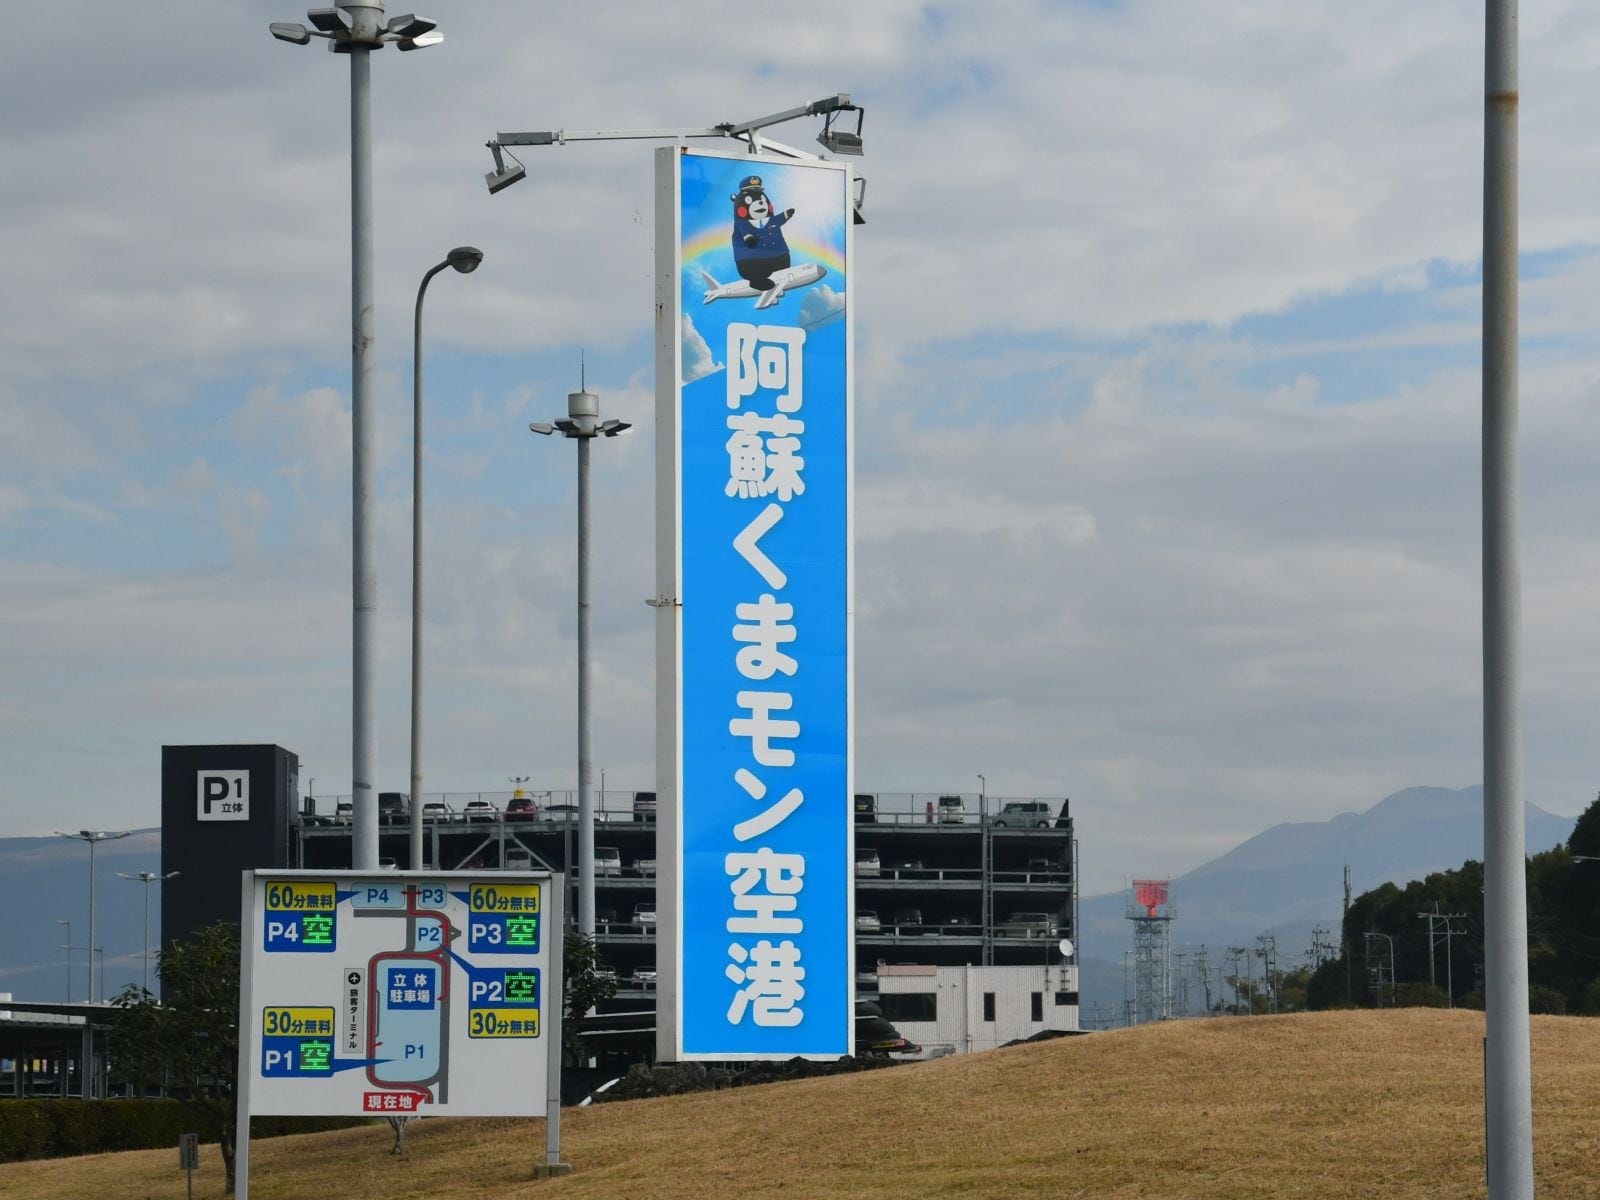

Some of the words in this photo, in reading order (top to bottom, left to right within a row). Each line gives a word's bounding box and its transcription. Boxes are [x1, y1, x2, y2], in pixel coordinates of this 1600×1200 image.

[725, 322, 806, 1027] 阿蘇くまモン空港
[204, 776, 242, 814] P1
[221, 802, 243, 813] 立体
[269, 886, 332, 908] 60分無料
[367, 889, 389, 903] P4
[422, 889, 443, 903] P3
[473, 888, 536, 910] 60分無料
[269, 922, 298, 942] P4
[303, 914, 333, 943] 空
[418, 927, 439, 941] P2
[472, 924, 501, 944] P3
[506, 916, 536, 945] 空
[394, 973, 427, 987] 立体
[472, 981, 502, 1001] P2
[505, 971, 535, 1002] 空
[390, 990, 430, 1003] 駐車場
[266, 1011, 330, 1034] 30分無料
[349, 989, 358, 1049] 旅客ターミナル
[472, 1012, 536, 1034] 30分無料
[265, 1050, 293, 1070] P1
[300, 1040, 331, 1070] 空
[405, 1044, 424, 1059] P1
[368, 1095, 412, 1109] 現在地
